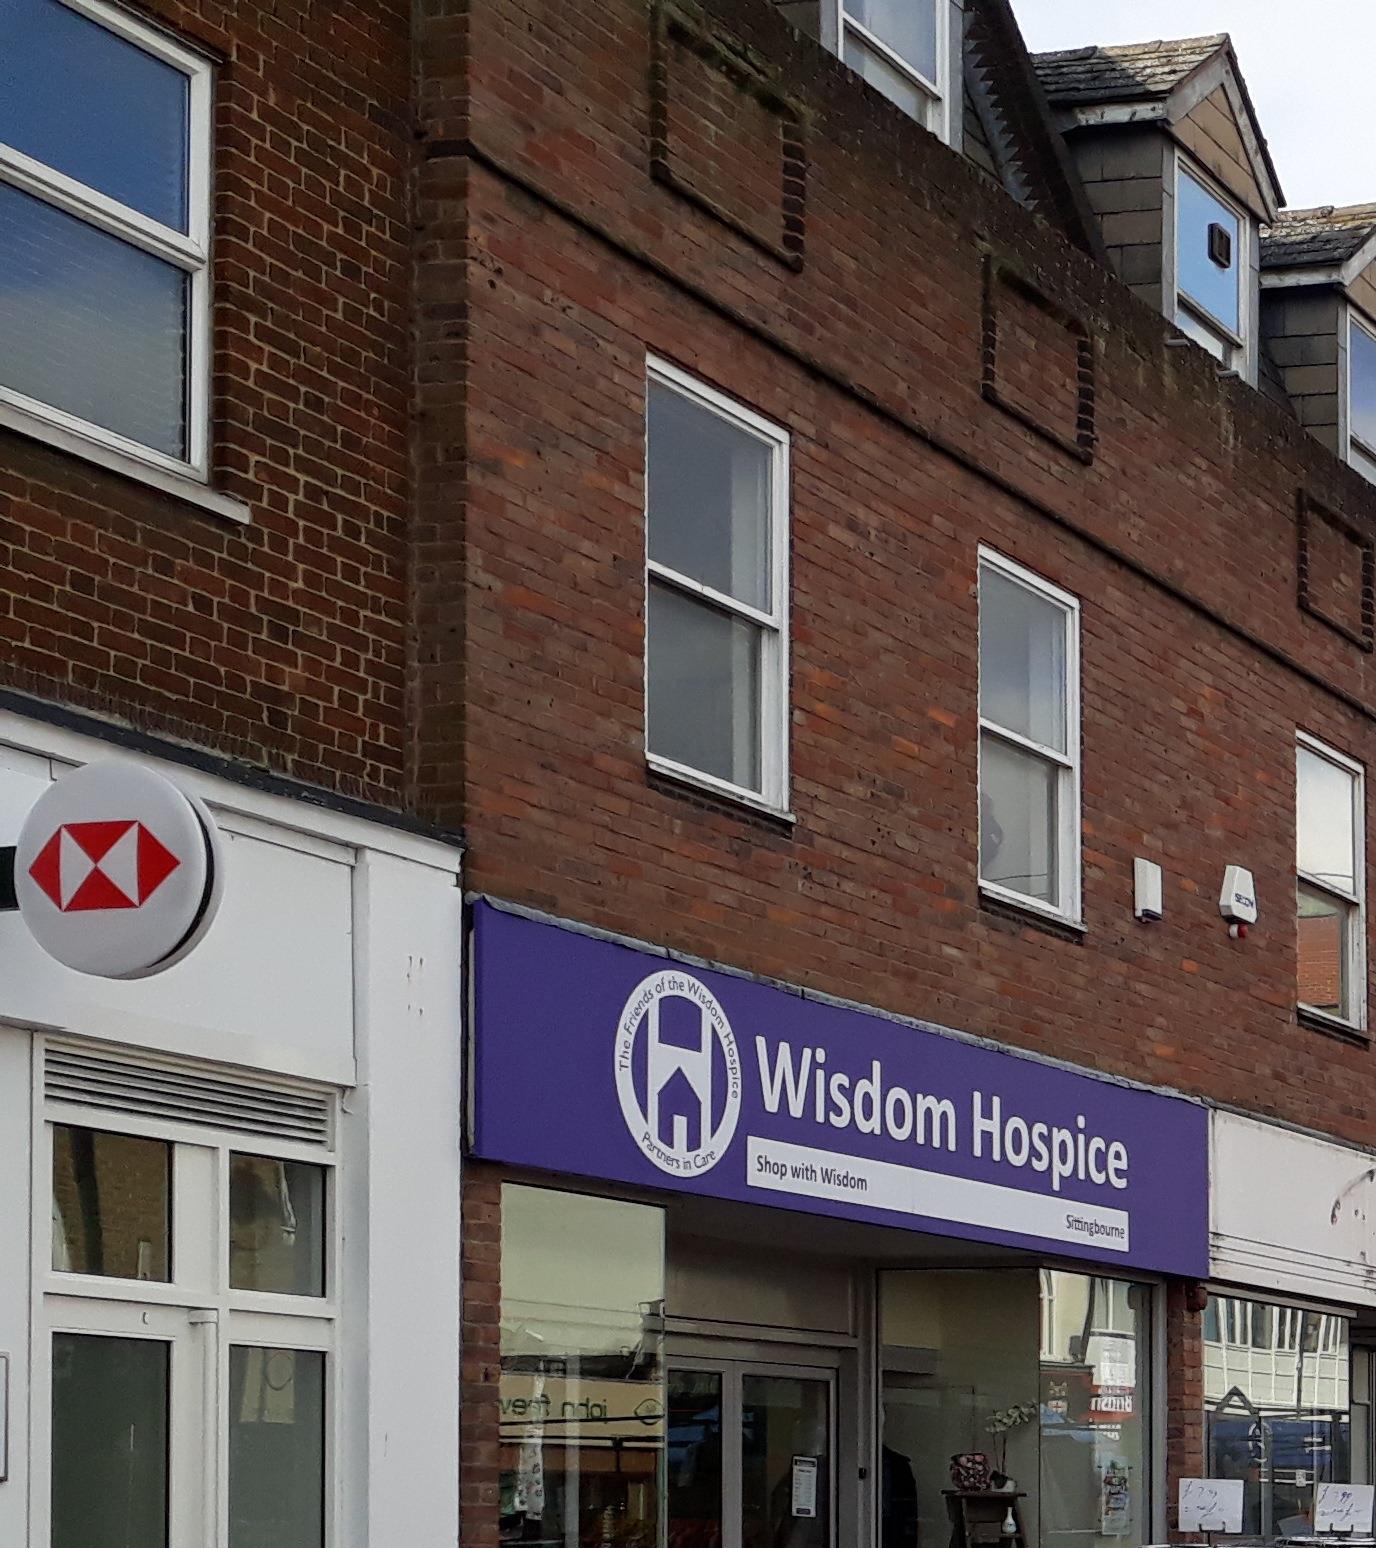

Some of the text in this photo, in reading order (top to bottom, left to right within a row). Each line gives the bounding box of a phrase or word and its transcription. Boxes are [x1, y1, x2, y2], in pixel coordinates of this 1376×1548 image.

[618, 975, 741, 1100] The Friends of the Wisdom Hospice
[755, 1035, 1129, 1192] Wisdom Hospice
[641, 1131, 716, 1170] Partners in Care
[756, 1154, 868, 1192] Shop with Wisdom
[1065, 1214, 1126, 1241] Sittingbourne
